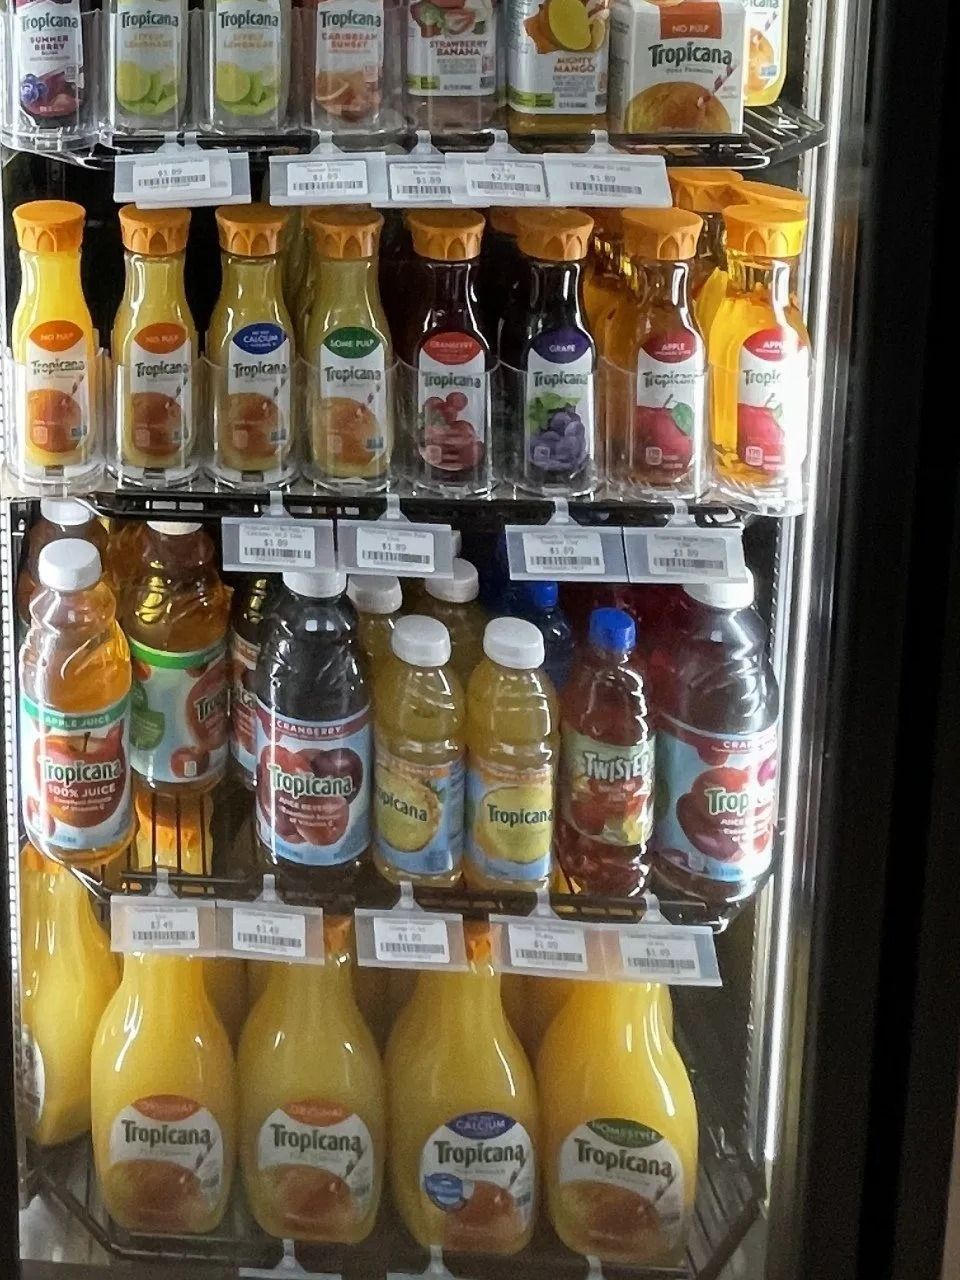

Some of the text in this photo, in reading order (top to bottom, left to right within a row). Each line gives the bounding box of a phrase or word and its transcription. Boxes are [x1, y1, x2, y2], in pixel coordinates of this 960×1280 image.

[20, 11, 80, 31] Tropicana
[120, 10, 180, 29] Tropicana
[218, 9, 279, 29] Tropicana
[319, 9, 382, 29] Tropicana
[671, 24, 710, 34] NO PULP
[436, 47, 481, 57] BANANA
[648, 41, 733, 68] Tropicana
[548, 343, 576, 353] GRAPE
[661, 342, 686, 351] APPLE
[31, 357, 86, 376] Tropicana
[134, 360, 190, 378] Tropicana
[233, 360, 288, 379] Tropicana
[324, 365, 382, 383] Tropicana
[424, 372, 481, 389] Tropicana
[276, 720, 342, 735] CRANBERRY
[38, 756, 122, 789] Tropicana
[268, 764, 353, 799] Tropicana
[81, 782, 116, 797] JUICE
[122, 1119, 212, 1148] Tropicana
[455, 1118, 506, 1130] CALCIUM
[270, 1123, 362, 1154] Tropicana
[433, 1140, 525, 1169] Tropicana
[573, 1137, 673, 1178] Tropicana
